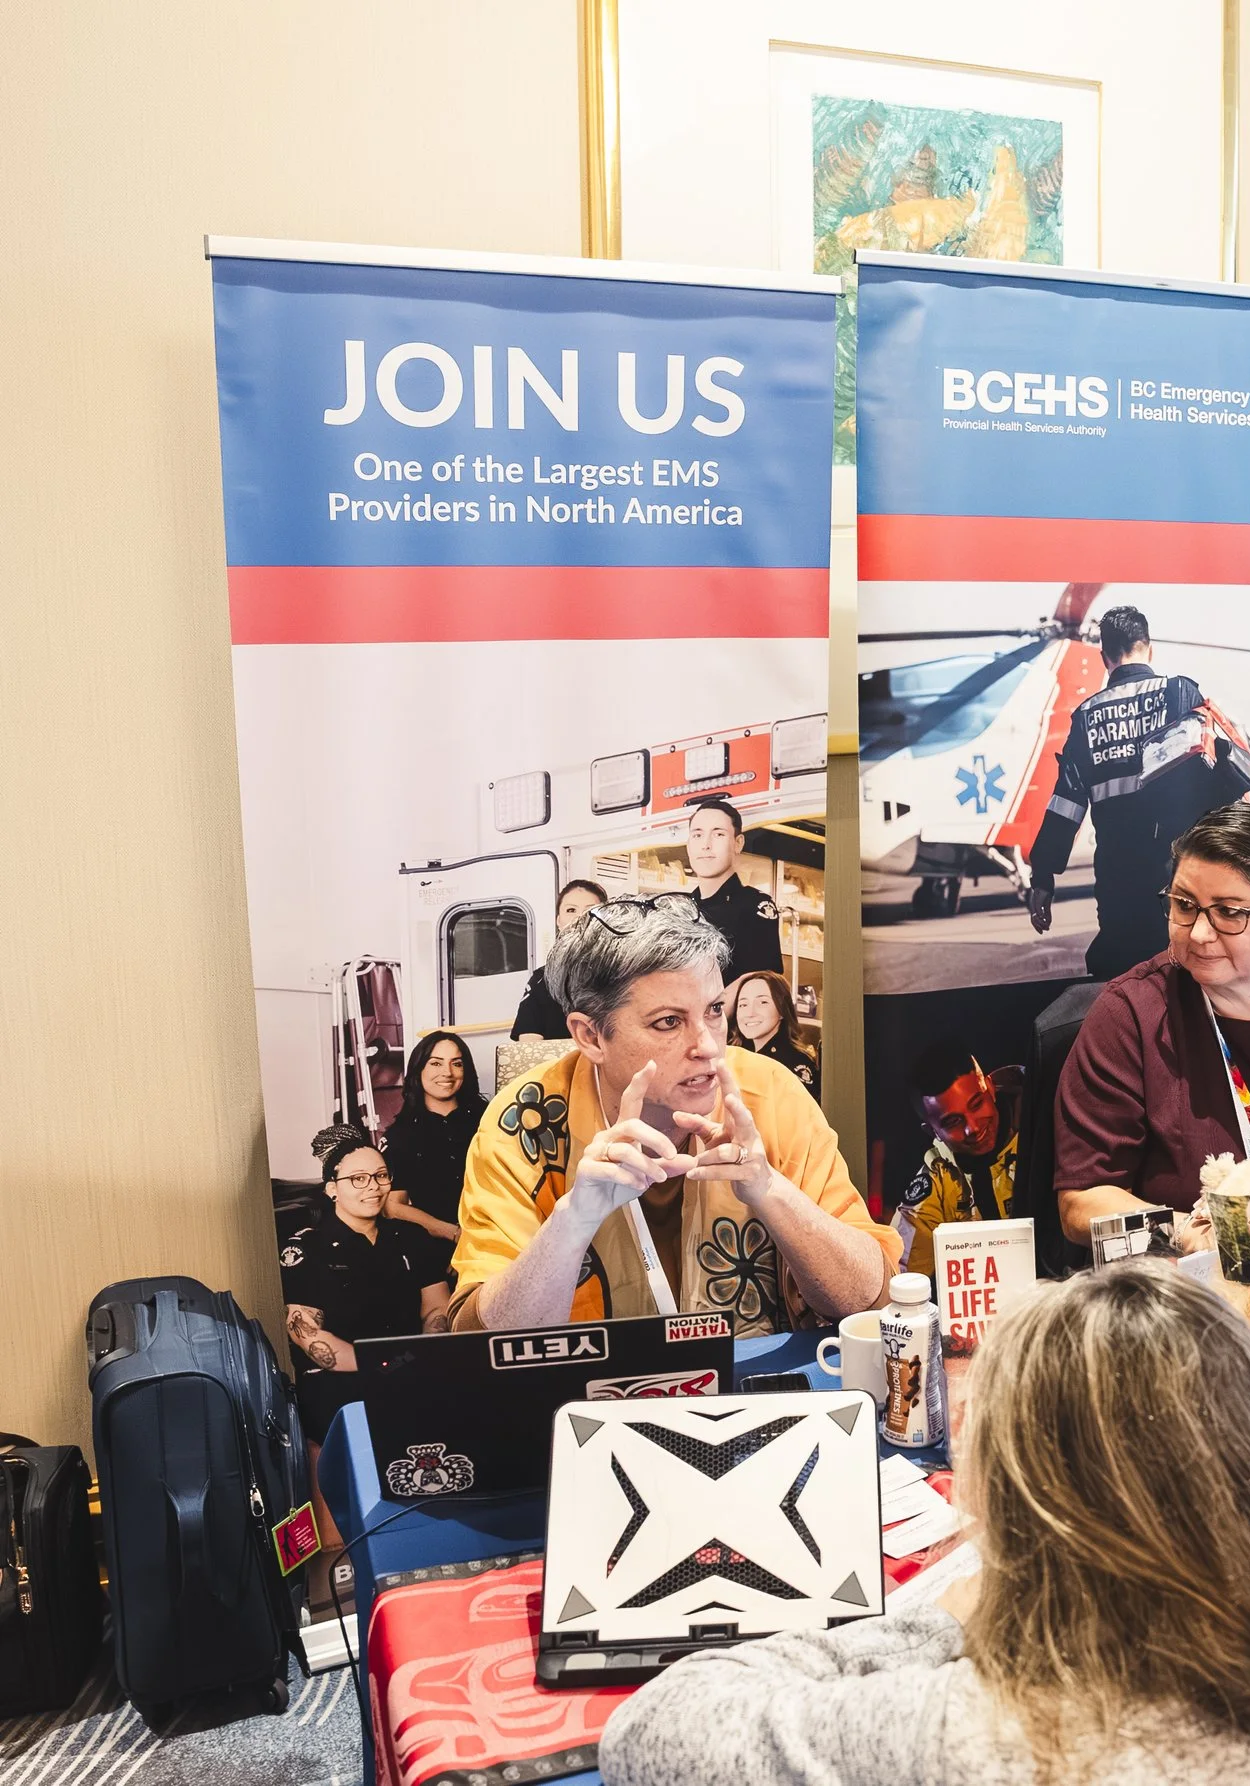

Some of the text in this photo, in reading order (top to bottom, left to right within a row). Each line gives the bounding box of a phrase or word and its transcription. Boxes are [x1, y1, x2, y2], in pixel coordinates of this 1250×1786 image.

[323, 339, 746, 438] JOIN US
[943, 368, 1109, 419] BCEHS
[1130, 380, 1250, 408] BC Emergency
[1130, 404, 1183, 423] Health
[943, 418, 1107, 438] Provincial Health Services Authority
[354, 453, 720, 491] One of the Largest EMS
[328, 492, 743, 527] Providers in North America
[1087, 700, 1142, 726] CRITICAL
[1092, 743, 1136, 765] BCEHS
[946, 1256, 1000, 1287] BE A
[948, 1288, 997, 1319] LIFE
[669, 1316, 719, 1328] NATION
[880, 1319, 913, 1338] fairlife
[949, 1321, 989, 1350] SAV
[502, 1336, 601, 1362] YETI
